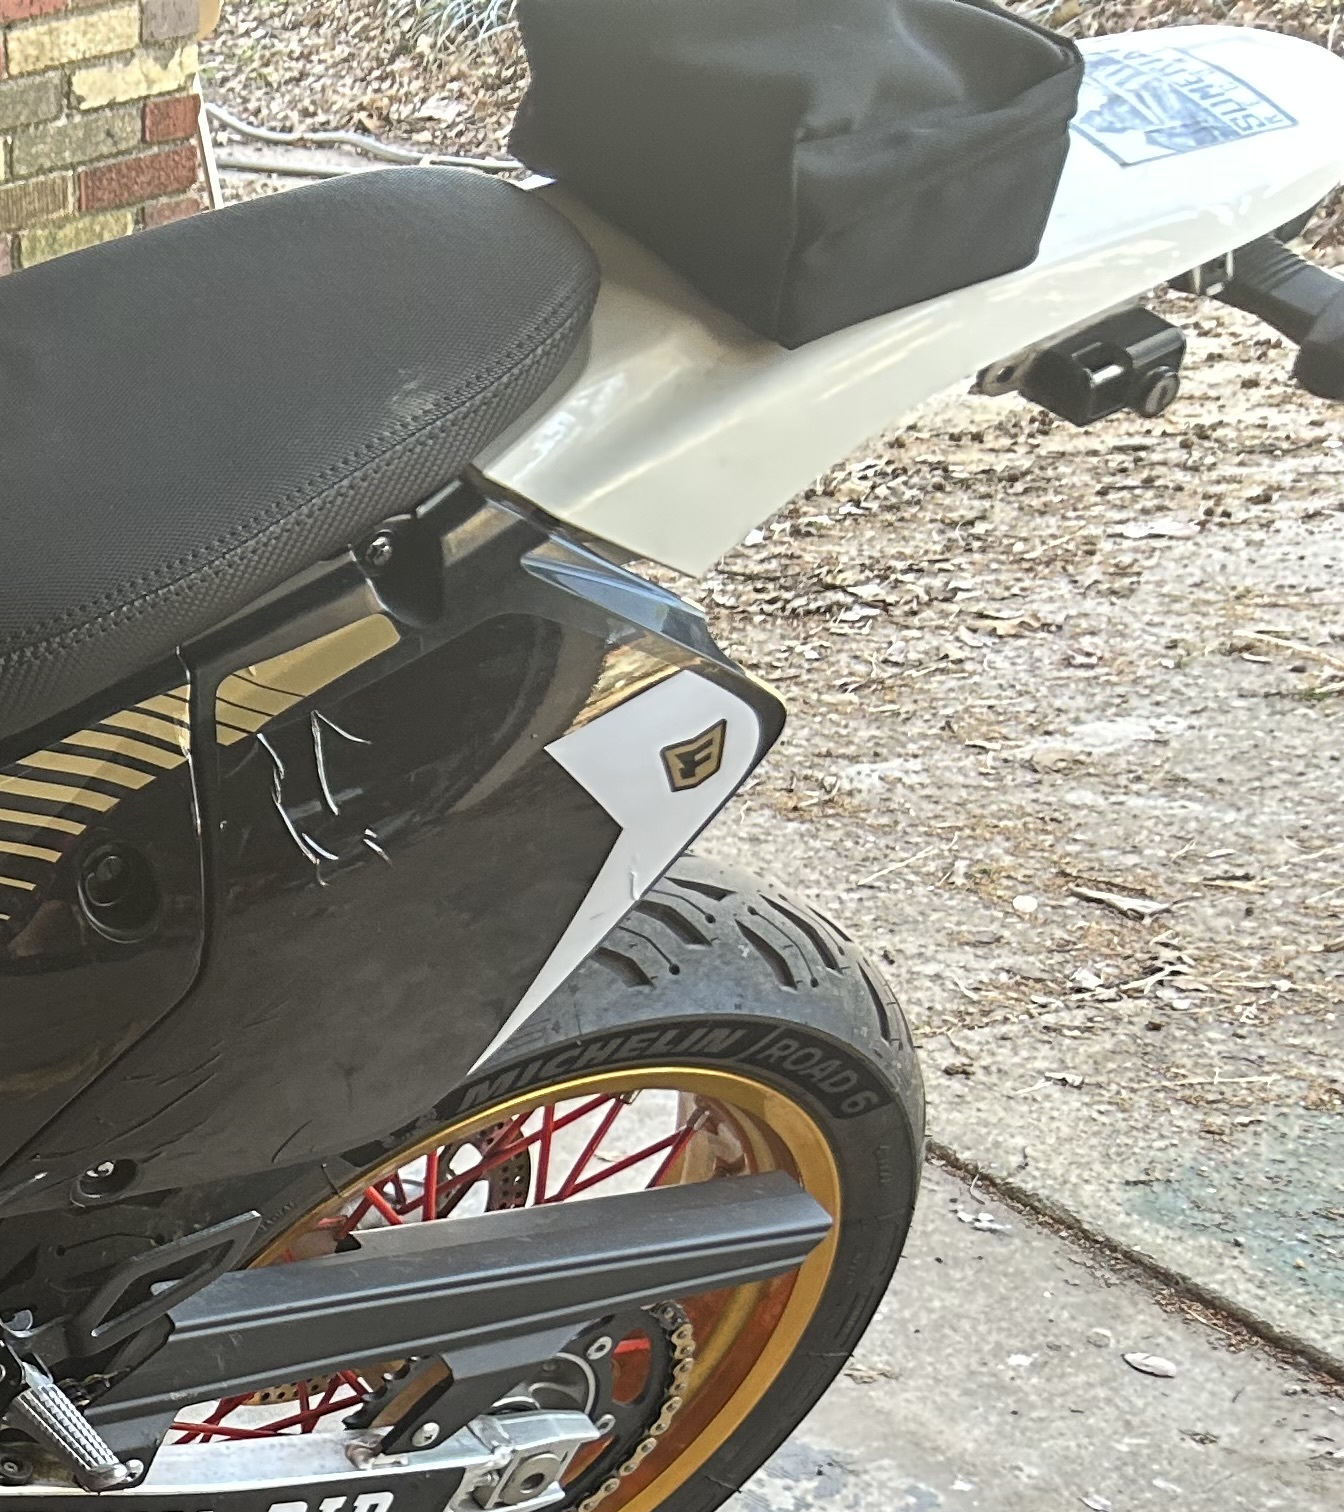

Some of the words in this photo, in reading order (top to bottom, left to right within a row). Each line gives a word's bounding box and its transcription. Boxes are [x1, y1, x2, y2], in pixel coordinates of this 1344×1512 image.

[462, 1027, 747, 1114] MICHELIN
[765, 1036, 858, 1092] ROAD
[840, 1090, 878, 1113] 6
